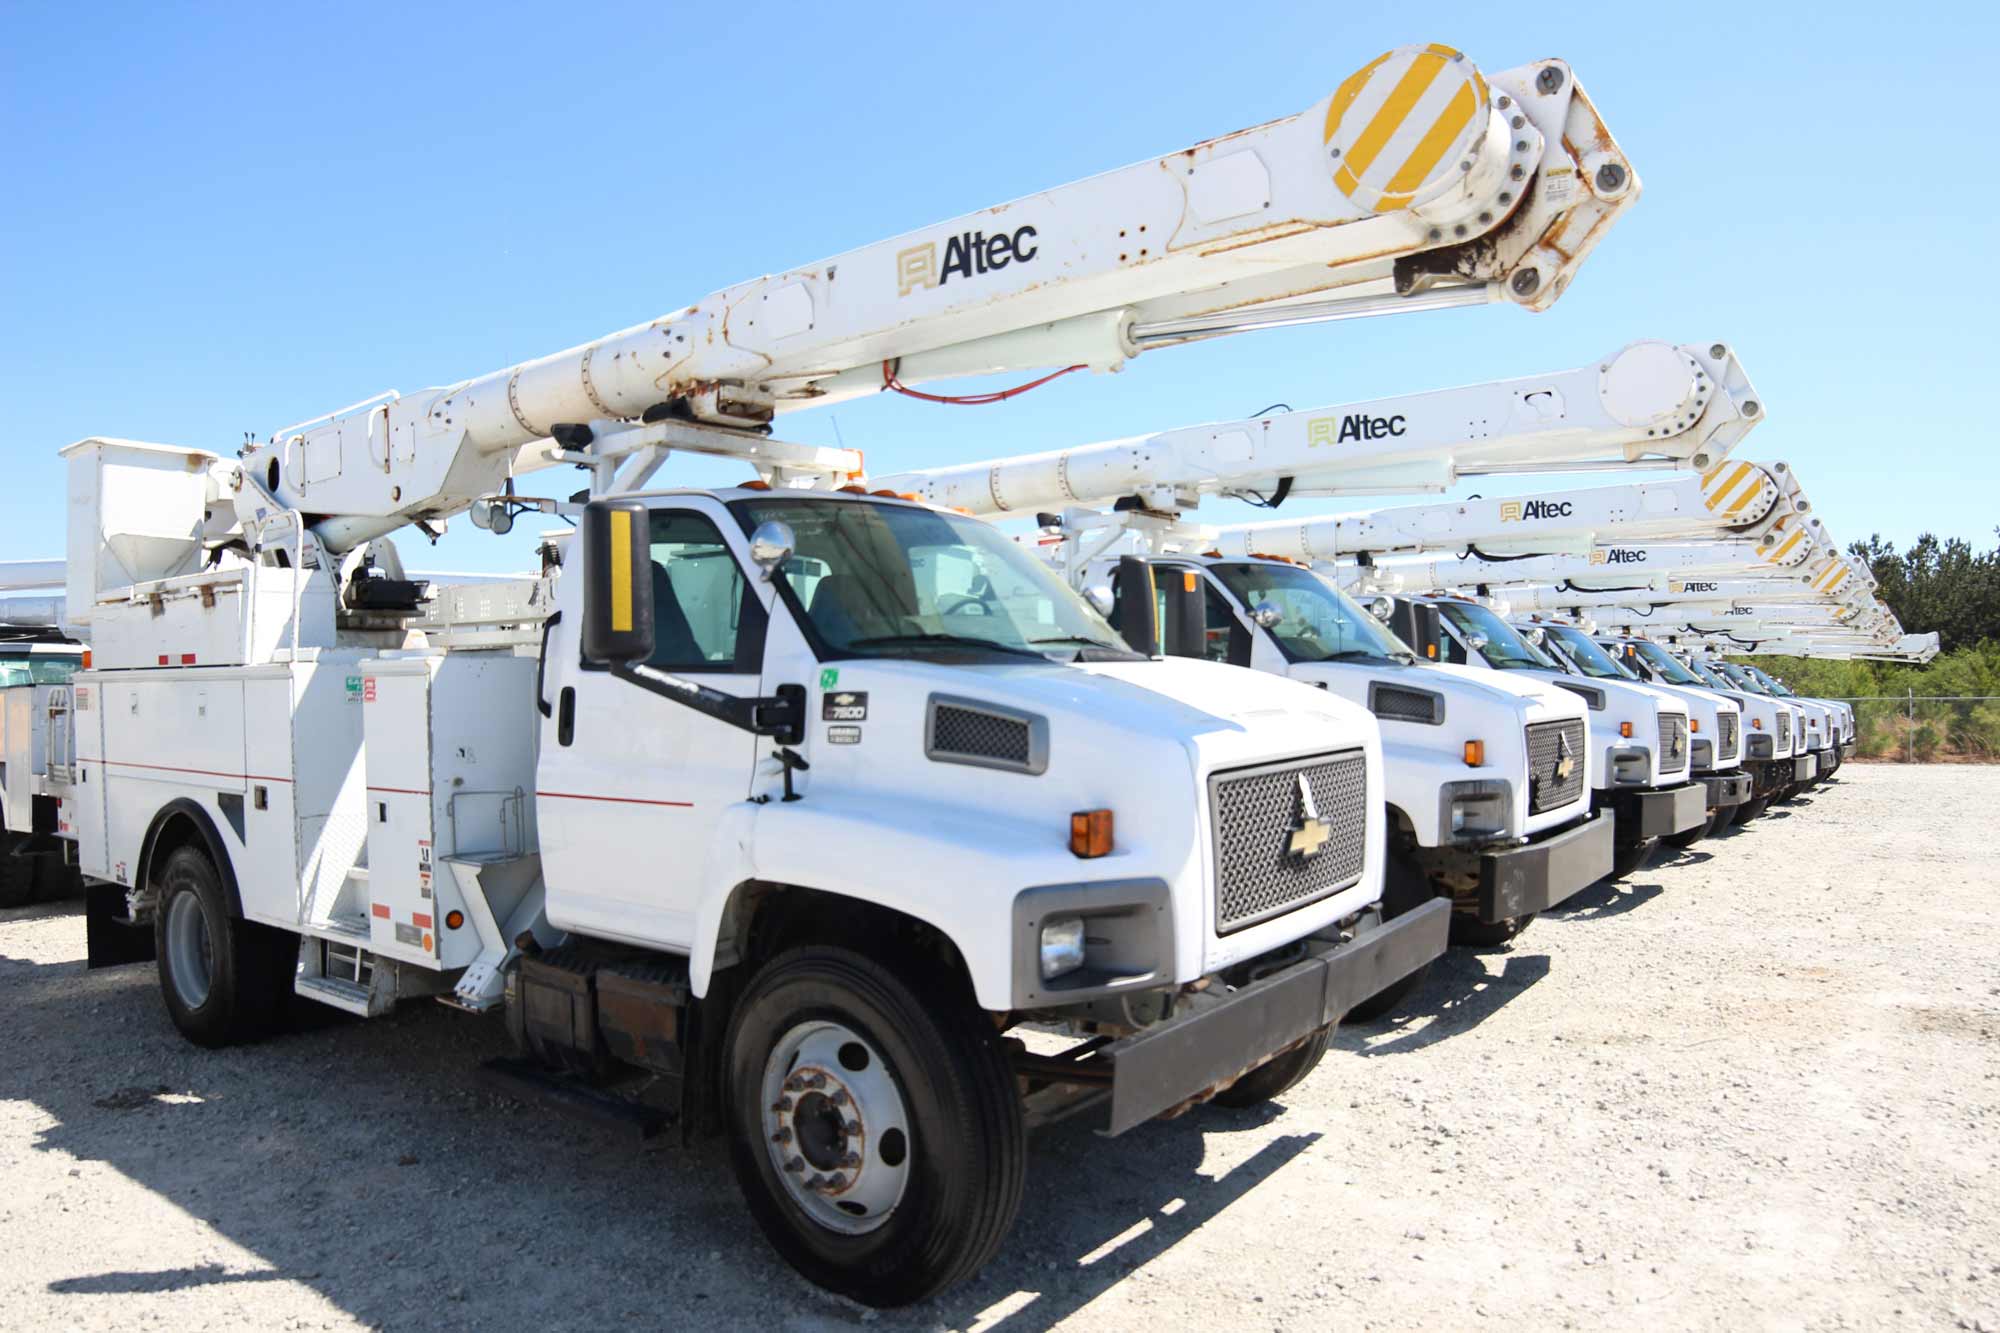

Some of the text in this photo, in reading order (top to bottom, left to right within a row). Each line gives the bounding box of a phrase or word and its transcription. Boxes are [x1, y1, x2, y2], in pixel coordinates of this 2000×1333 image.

[938, 225, 1038, 286] Altec
[1337, 414, 1406, 444] Altec
[1522, 499, 1573, 521] Altec
[1607, 549, 1647, 564] Altec
